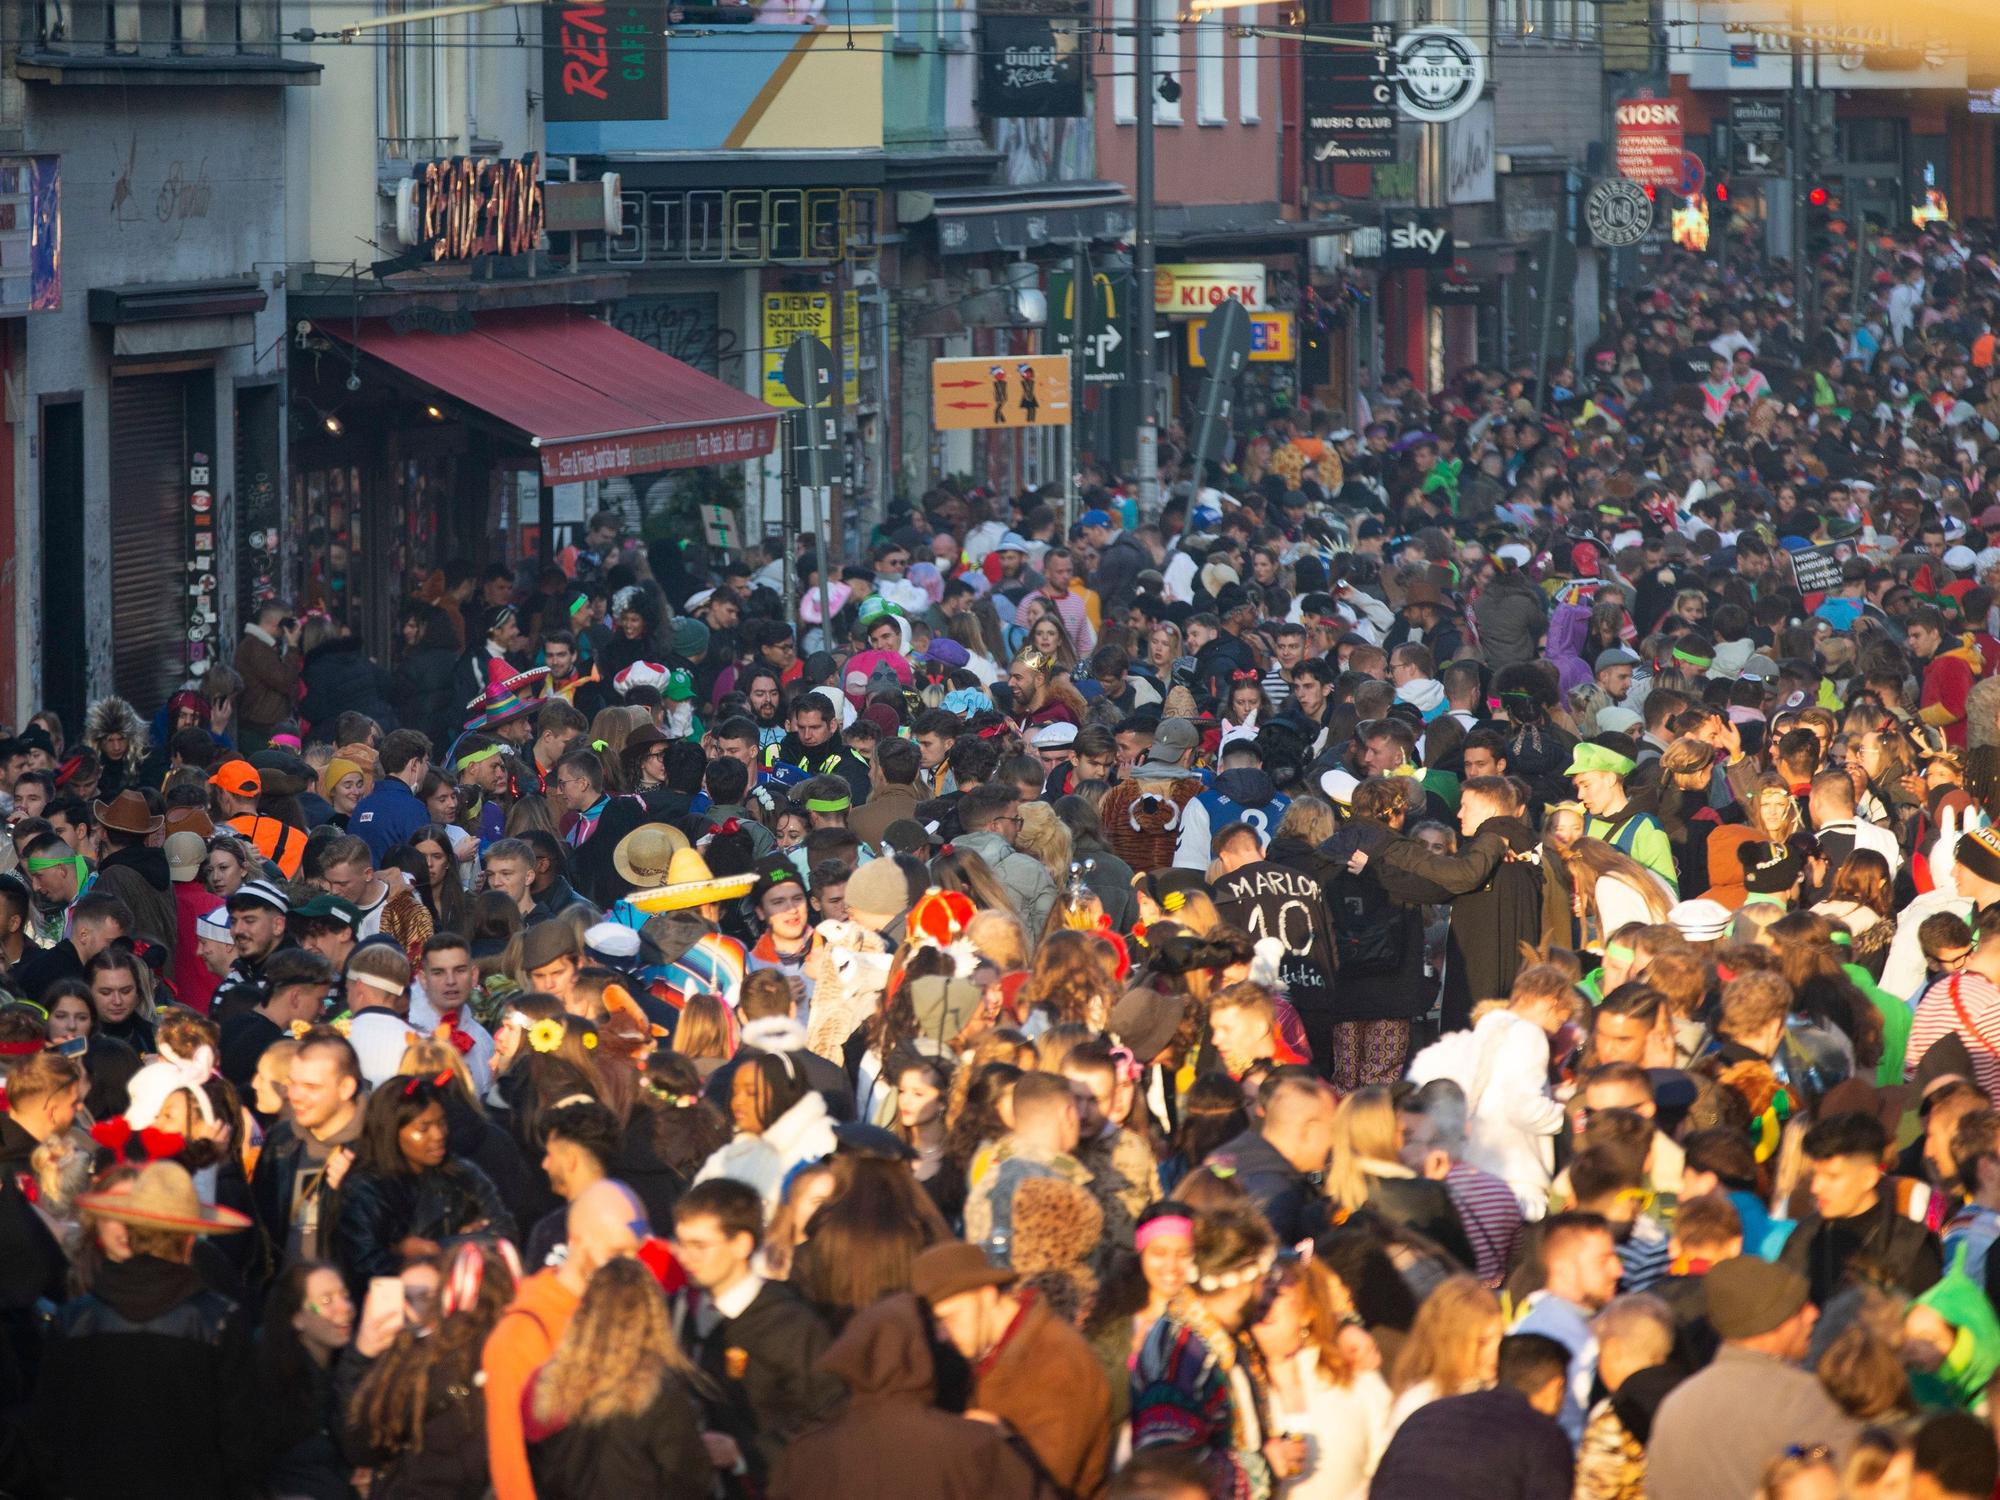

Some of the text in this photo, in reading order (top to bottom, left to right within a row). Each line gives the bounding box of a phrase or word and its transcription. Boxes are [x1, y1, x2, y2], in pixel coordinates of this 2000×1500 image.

[616, 25, 645, 80] CAFÉ
[1004, 46, 1058, 67] Gaffel
[1310, 116, 1392, 129] MUSIC CLUB
[1615, 104, 1680, 125] KIOSK
[612, 199, 873, 252] STIEFEL
[1391, 221, 1446, 255] sky
[784, 296, 810, 311] KEIN
[768, 313, 825, 328] SCHLUSS-
[1248, 900, 1314, 957] 10
